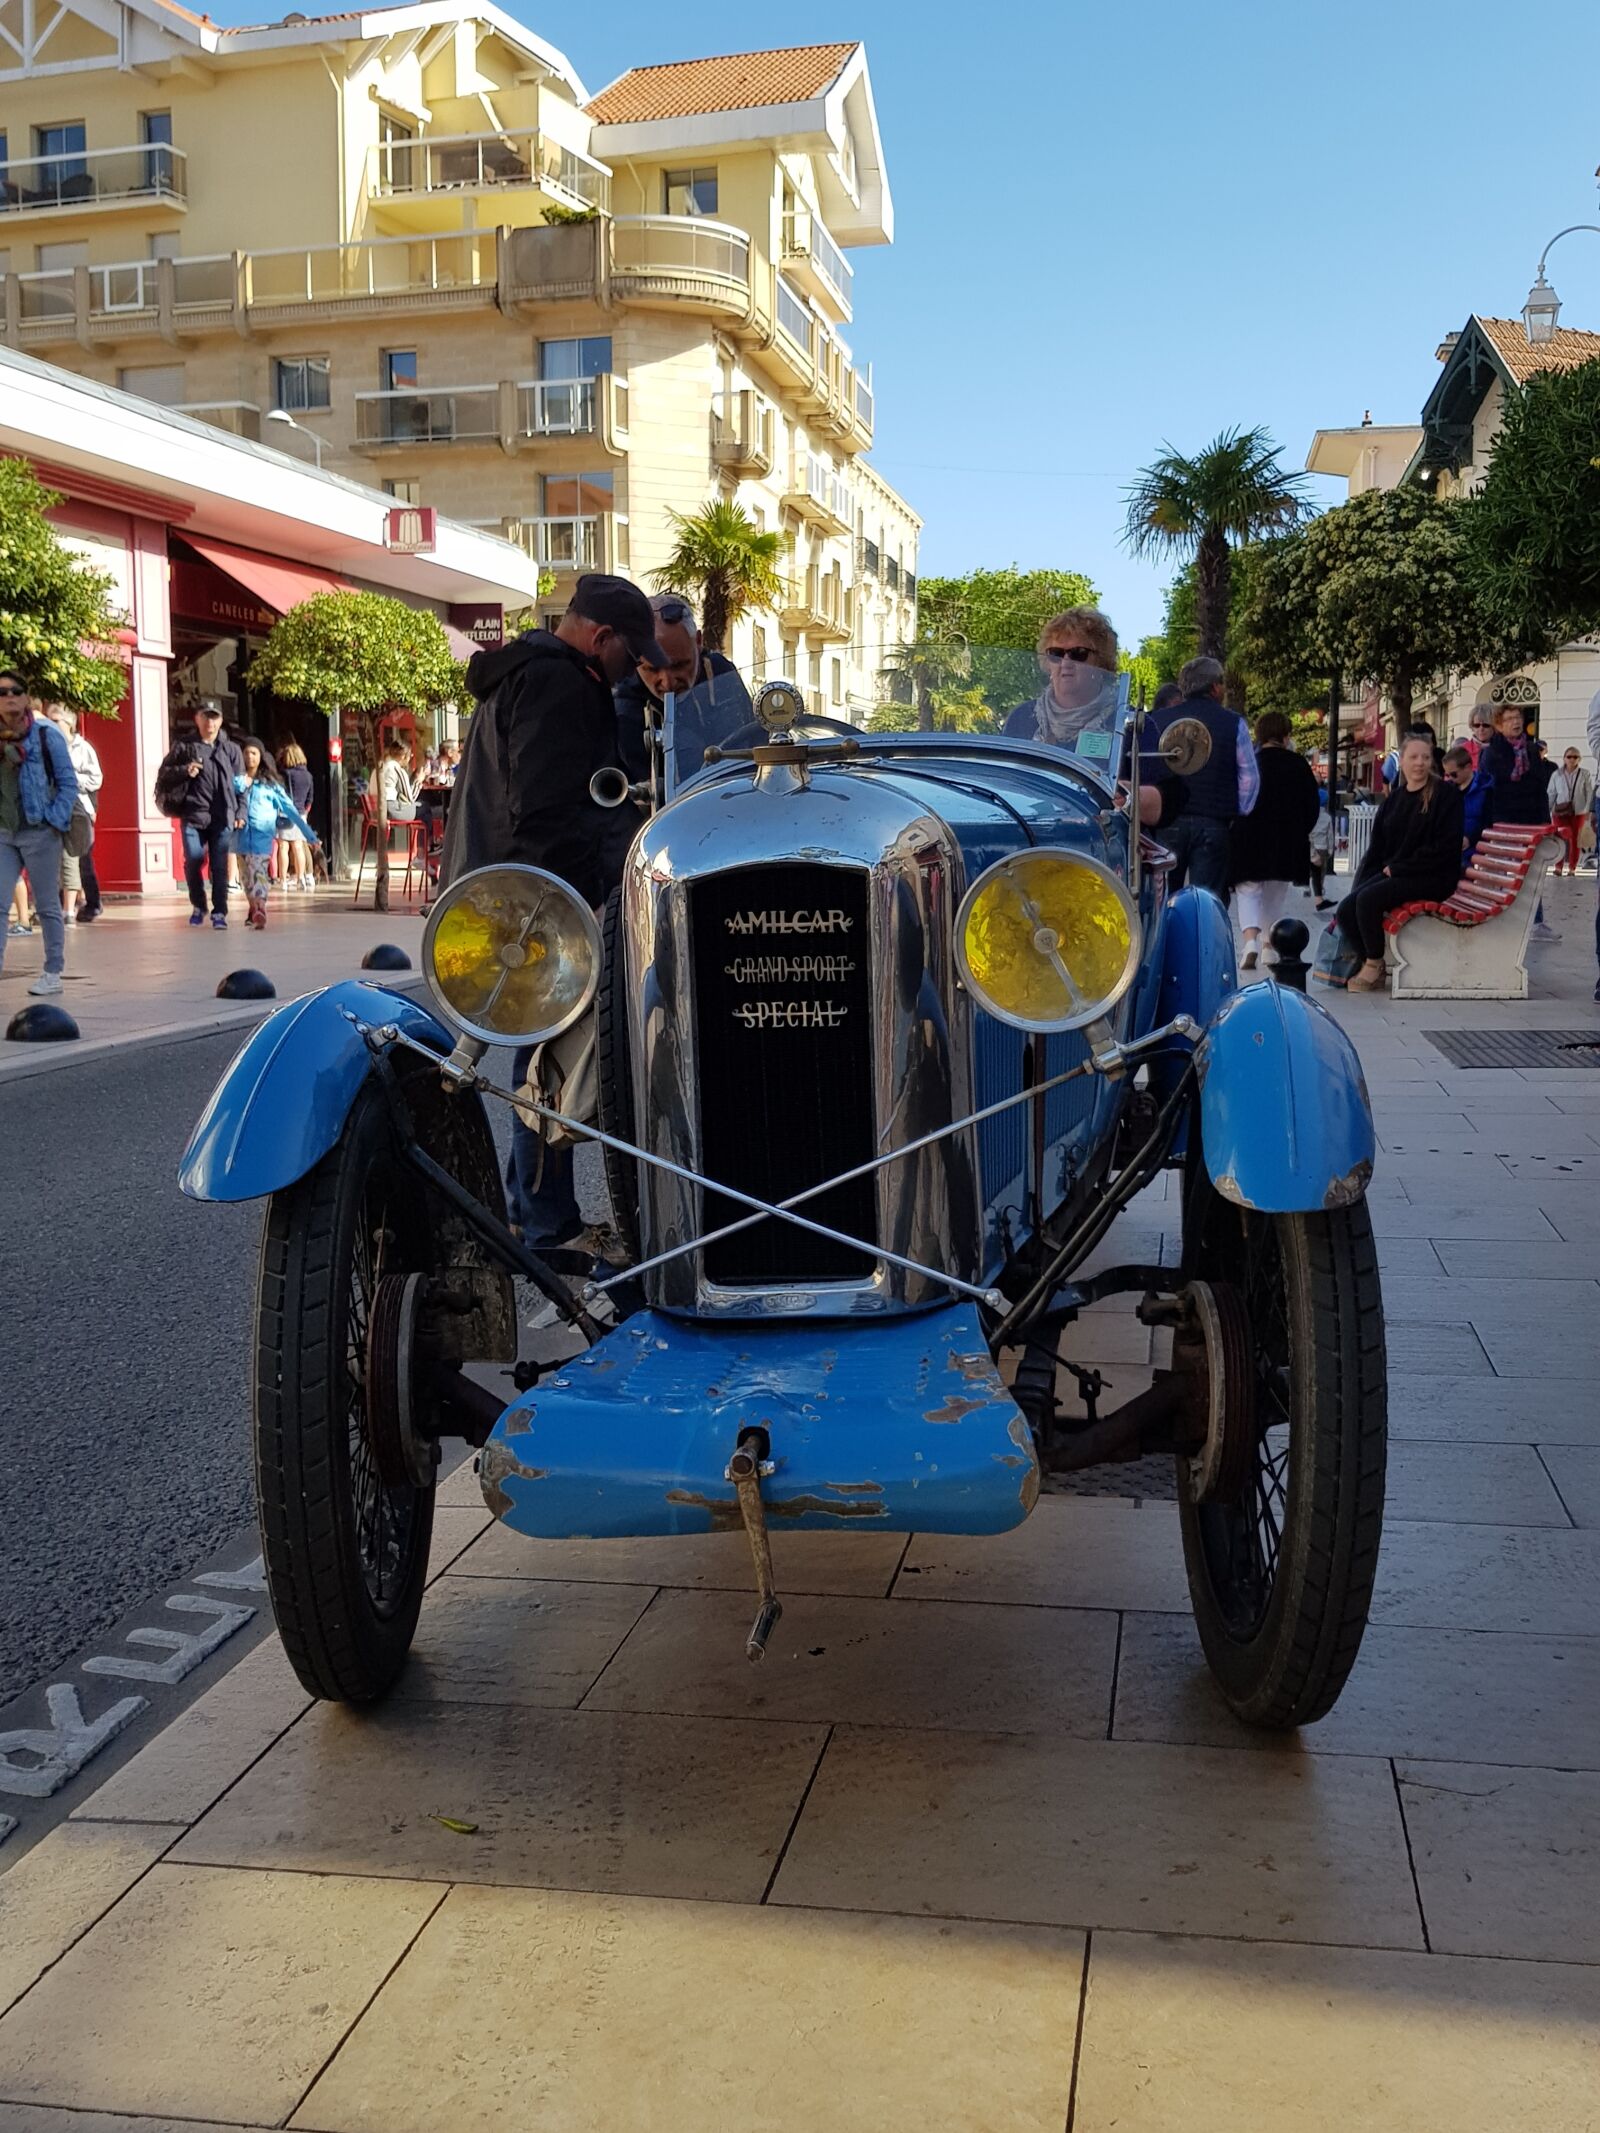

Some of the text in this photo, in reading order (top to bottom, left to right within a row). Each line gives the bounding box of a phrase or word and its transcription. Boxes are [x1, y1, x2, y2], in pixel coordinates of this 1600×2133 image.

[473, 618, 501, 630] ALAIN
[726, 909, 852, 935] AMILCAR
[733, 955, 849, 984] GRAND SPORT
[741, 1000, 842, 1029] SPECIAL
